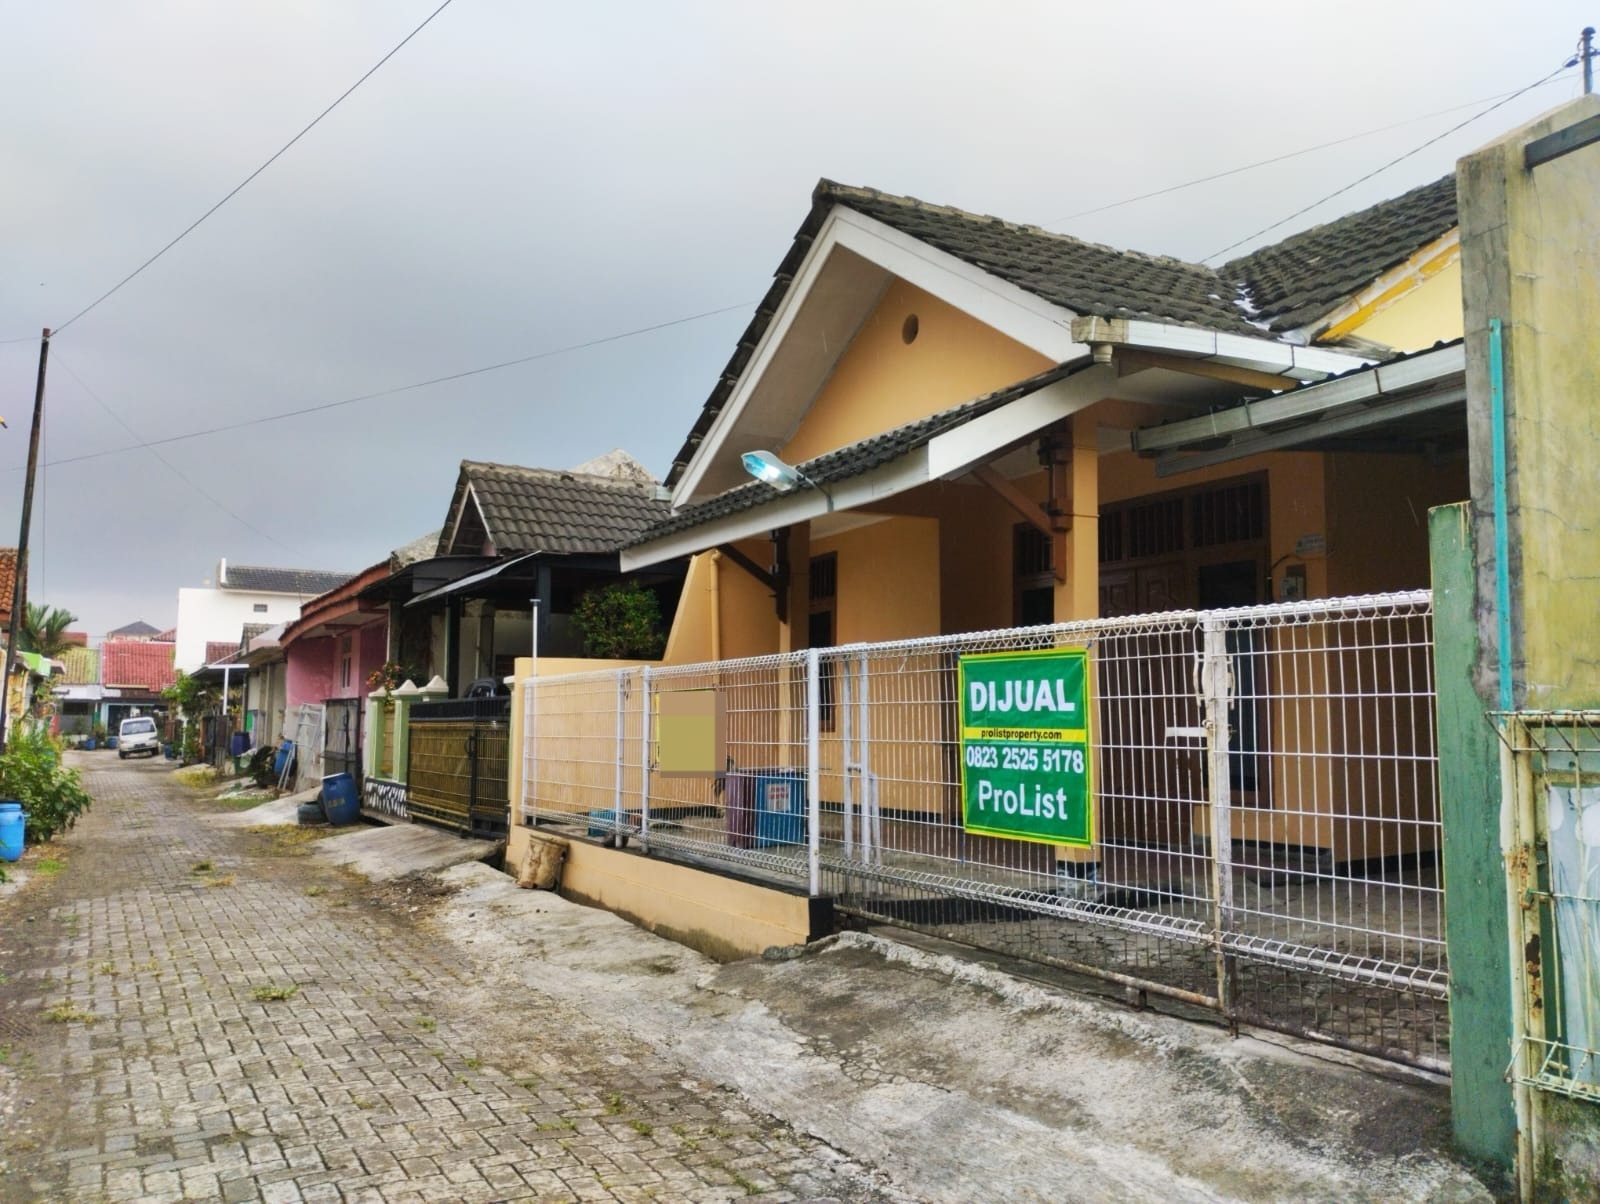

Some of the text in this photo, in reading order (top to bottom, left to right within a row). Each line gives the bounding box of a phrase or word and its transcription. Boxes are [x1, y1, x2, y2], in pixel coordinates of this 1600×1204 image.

[970, 679, 1075, 712] DIJUAL
[981, 728, 1062, 741] prolistproperty.com
[966, 746, 1084, 774] 0823 2525 5178
[978, 779, 1067, 820] ProList
